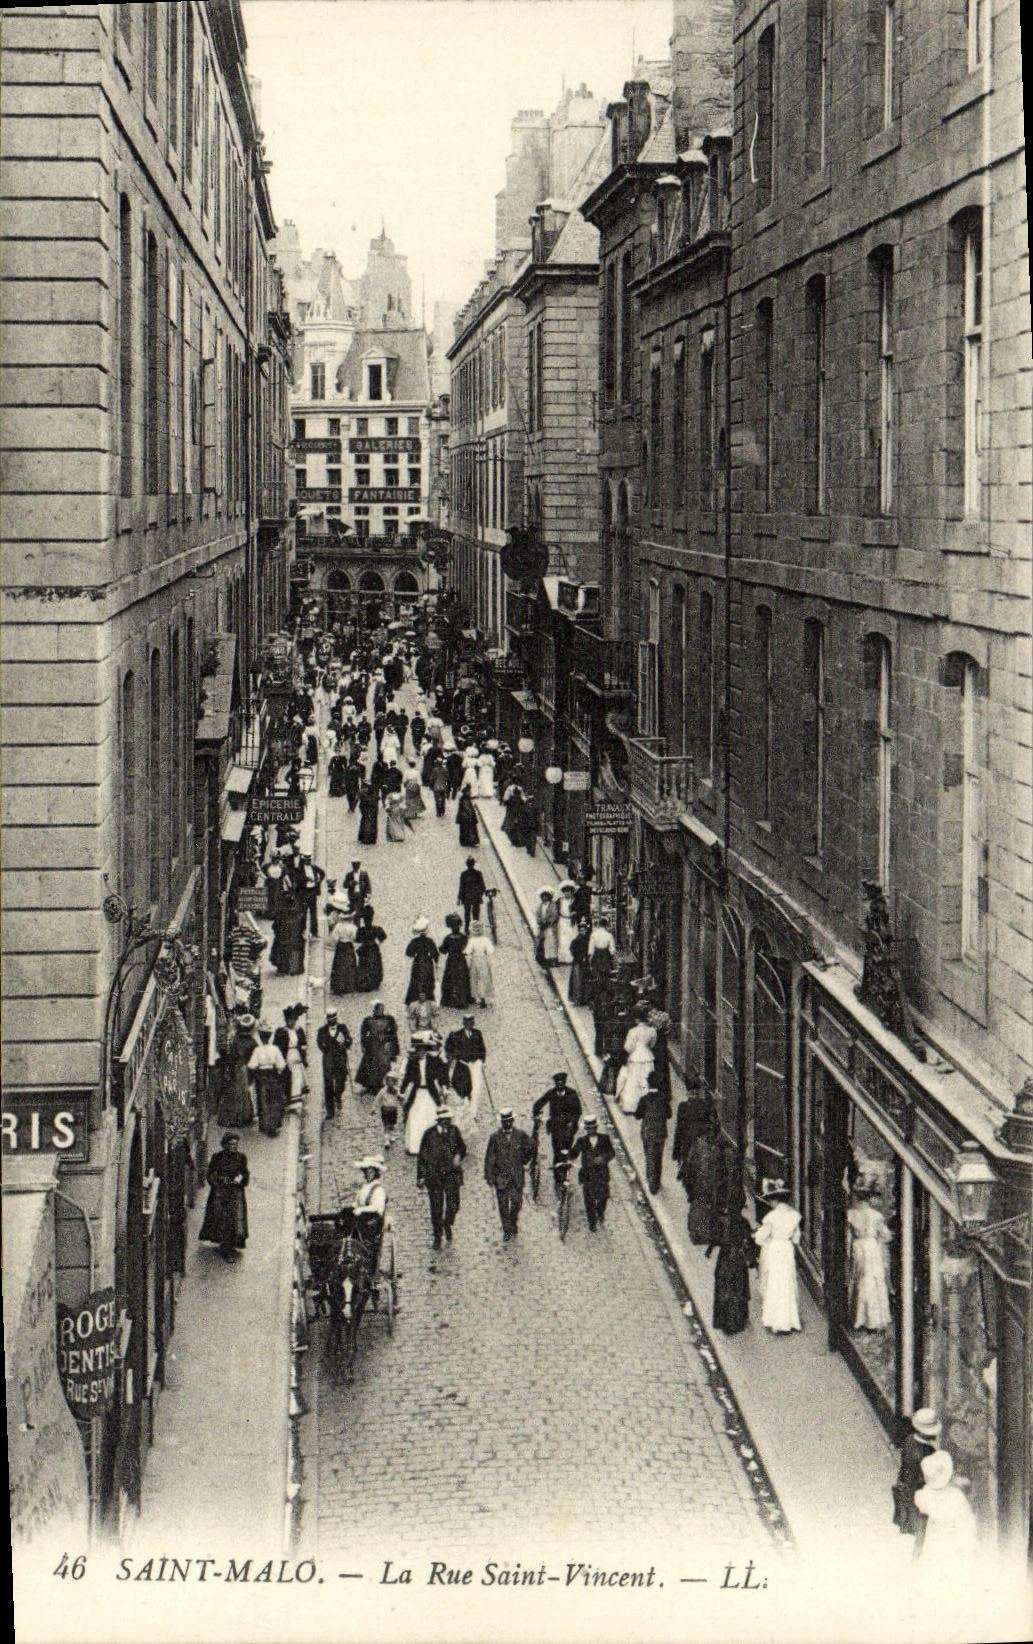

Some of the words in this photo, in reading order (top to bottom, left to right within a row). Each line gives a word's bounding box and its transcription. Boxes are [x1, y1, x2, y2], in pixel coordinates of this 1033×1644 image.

[356, 440, 414, 450] GALERIES
[354, 490, 416, 500] FANTAISIE
[250, 811, 302, 822] CENTRALE
[2, 1111, 75, 1149] RIS
